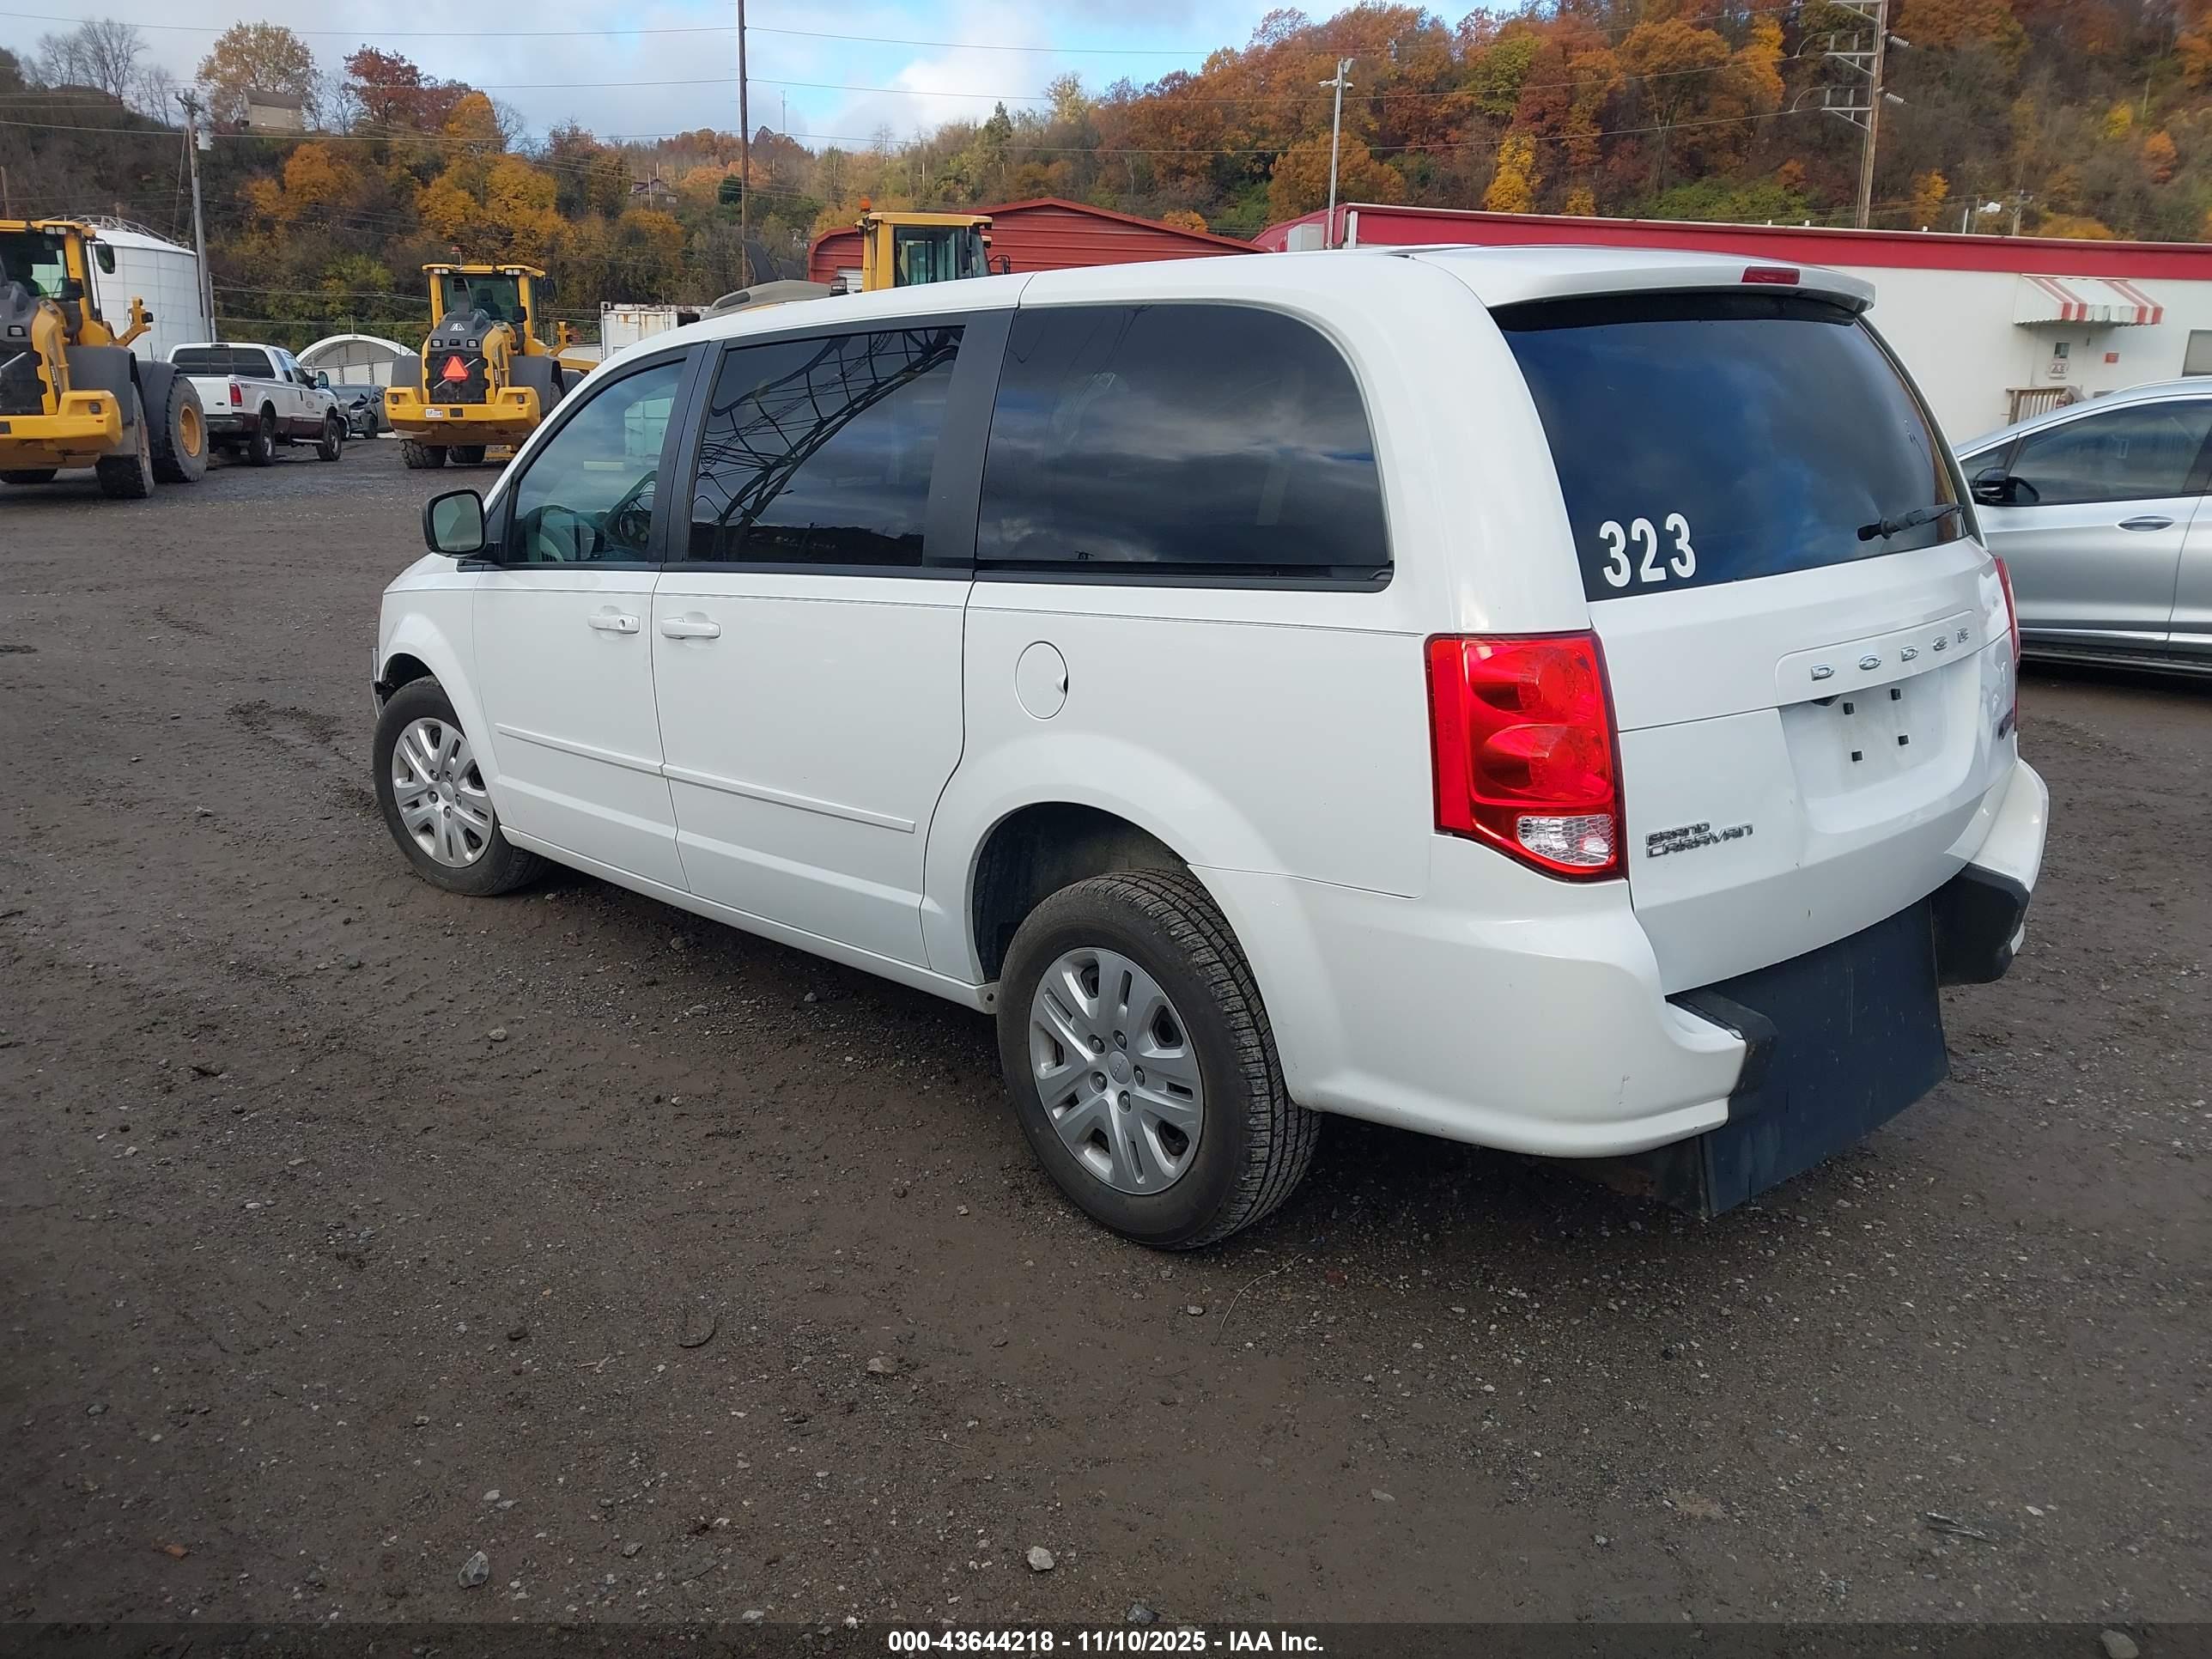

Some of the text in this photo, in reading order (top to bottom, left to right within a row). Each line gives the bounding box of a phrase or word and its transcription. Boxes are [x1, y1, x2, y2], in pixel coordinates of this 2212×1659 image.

[1599, 513, 1696, 587] 323
[1810, 627, 1969, 681] DODGE
[1646, 822, 1711, 846] GRAND
[1646, 823, 1753, 858] CARAVAN
